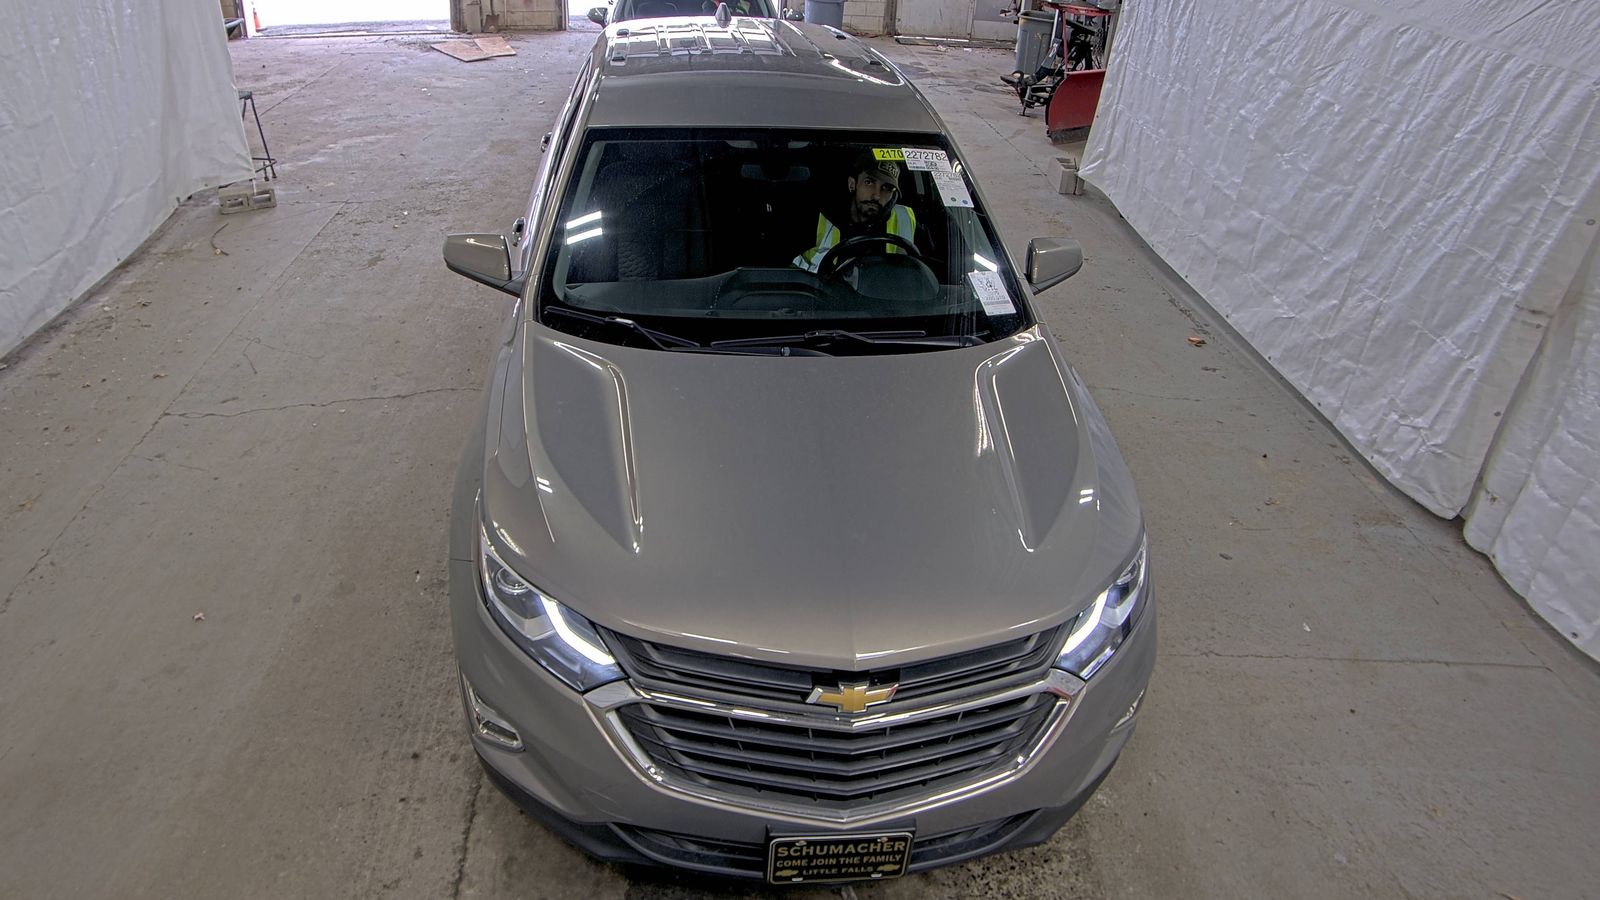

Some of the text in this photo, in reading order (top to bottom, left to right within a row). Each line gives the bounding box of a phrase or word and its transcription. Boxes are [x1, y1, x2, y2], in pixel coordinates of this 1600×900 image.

[880, 149, 904, 159] 2170
[904, 150, 947, 161] 2272782
[777, 841, 906, 857] SCHUMACHER
[776, 854, 902, 868] COME JOIN THE FAMILY
[803, 868, 838, 876] LITTLE
